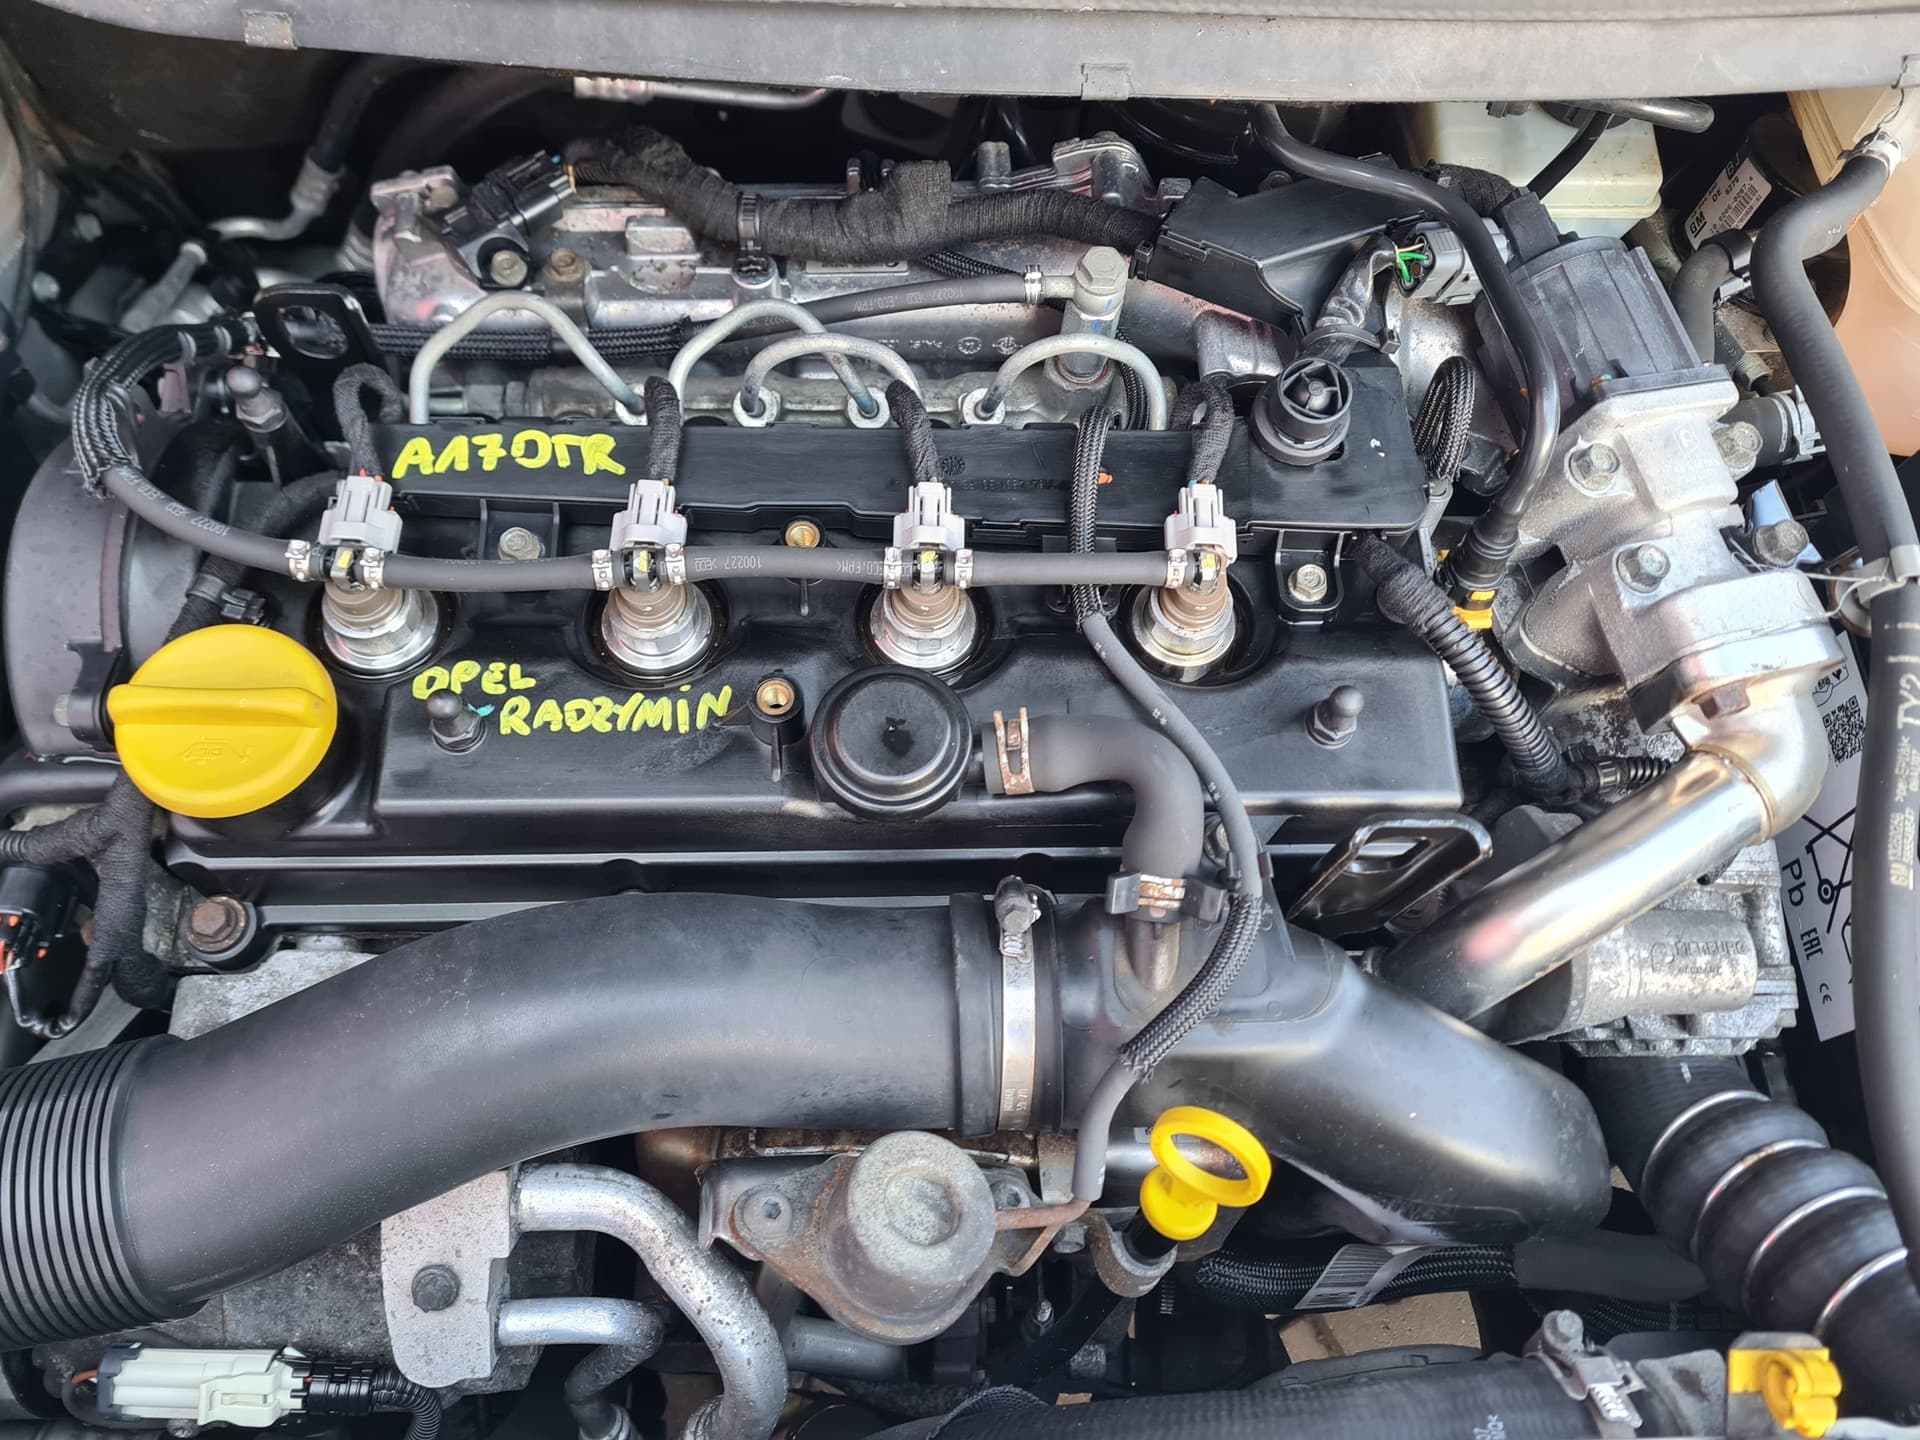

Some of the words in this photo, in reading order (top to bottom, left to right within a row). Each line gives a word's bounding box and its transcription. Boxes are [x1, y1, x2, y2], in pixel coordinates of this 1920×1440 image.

[1689, 211, 1706, 234] GM
[724, 555, 762, 570] 100227
[412, 660, 537, 699] OPEL
[1782, 858, 1807, 907] Pb
